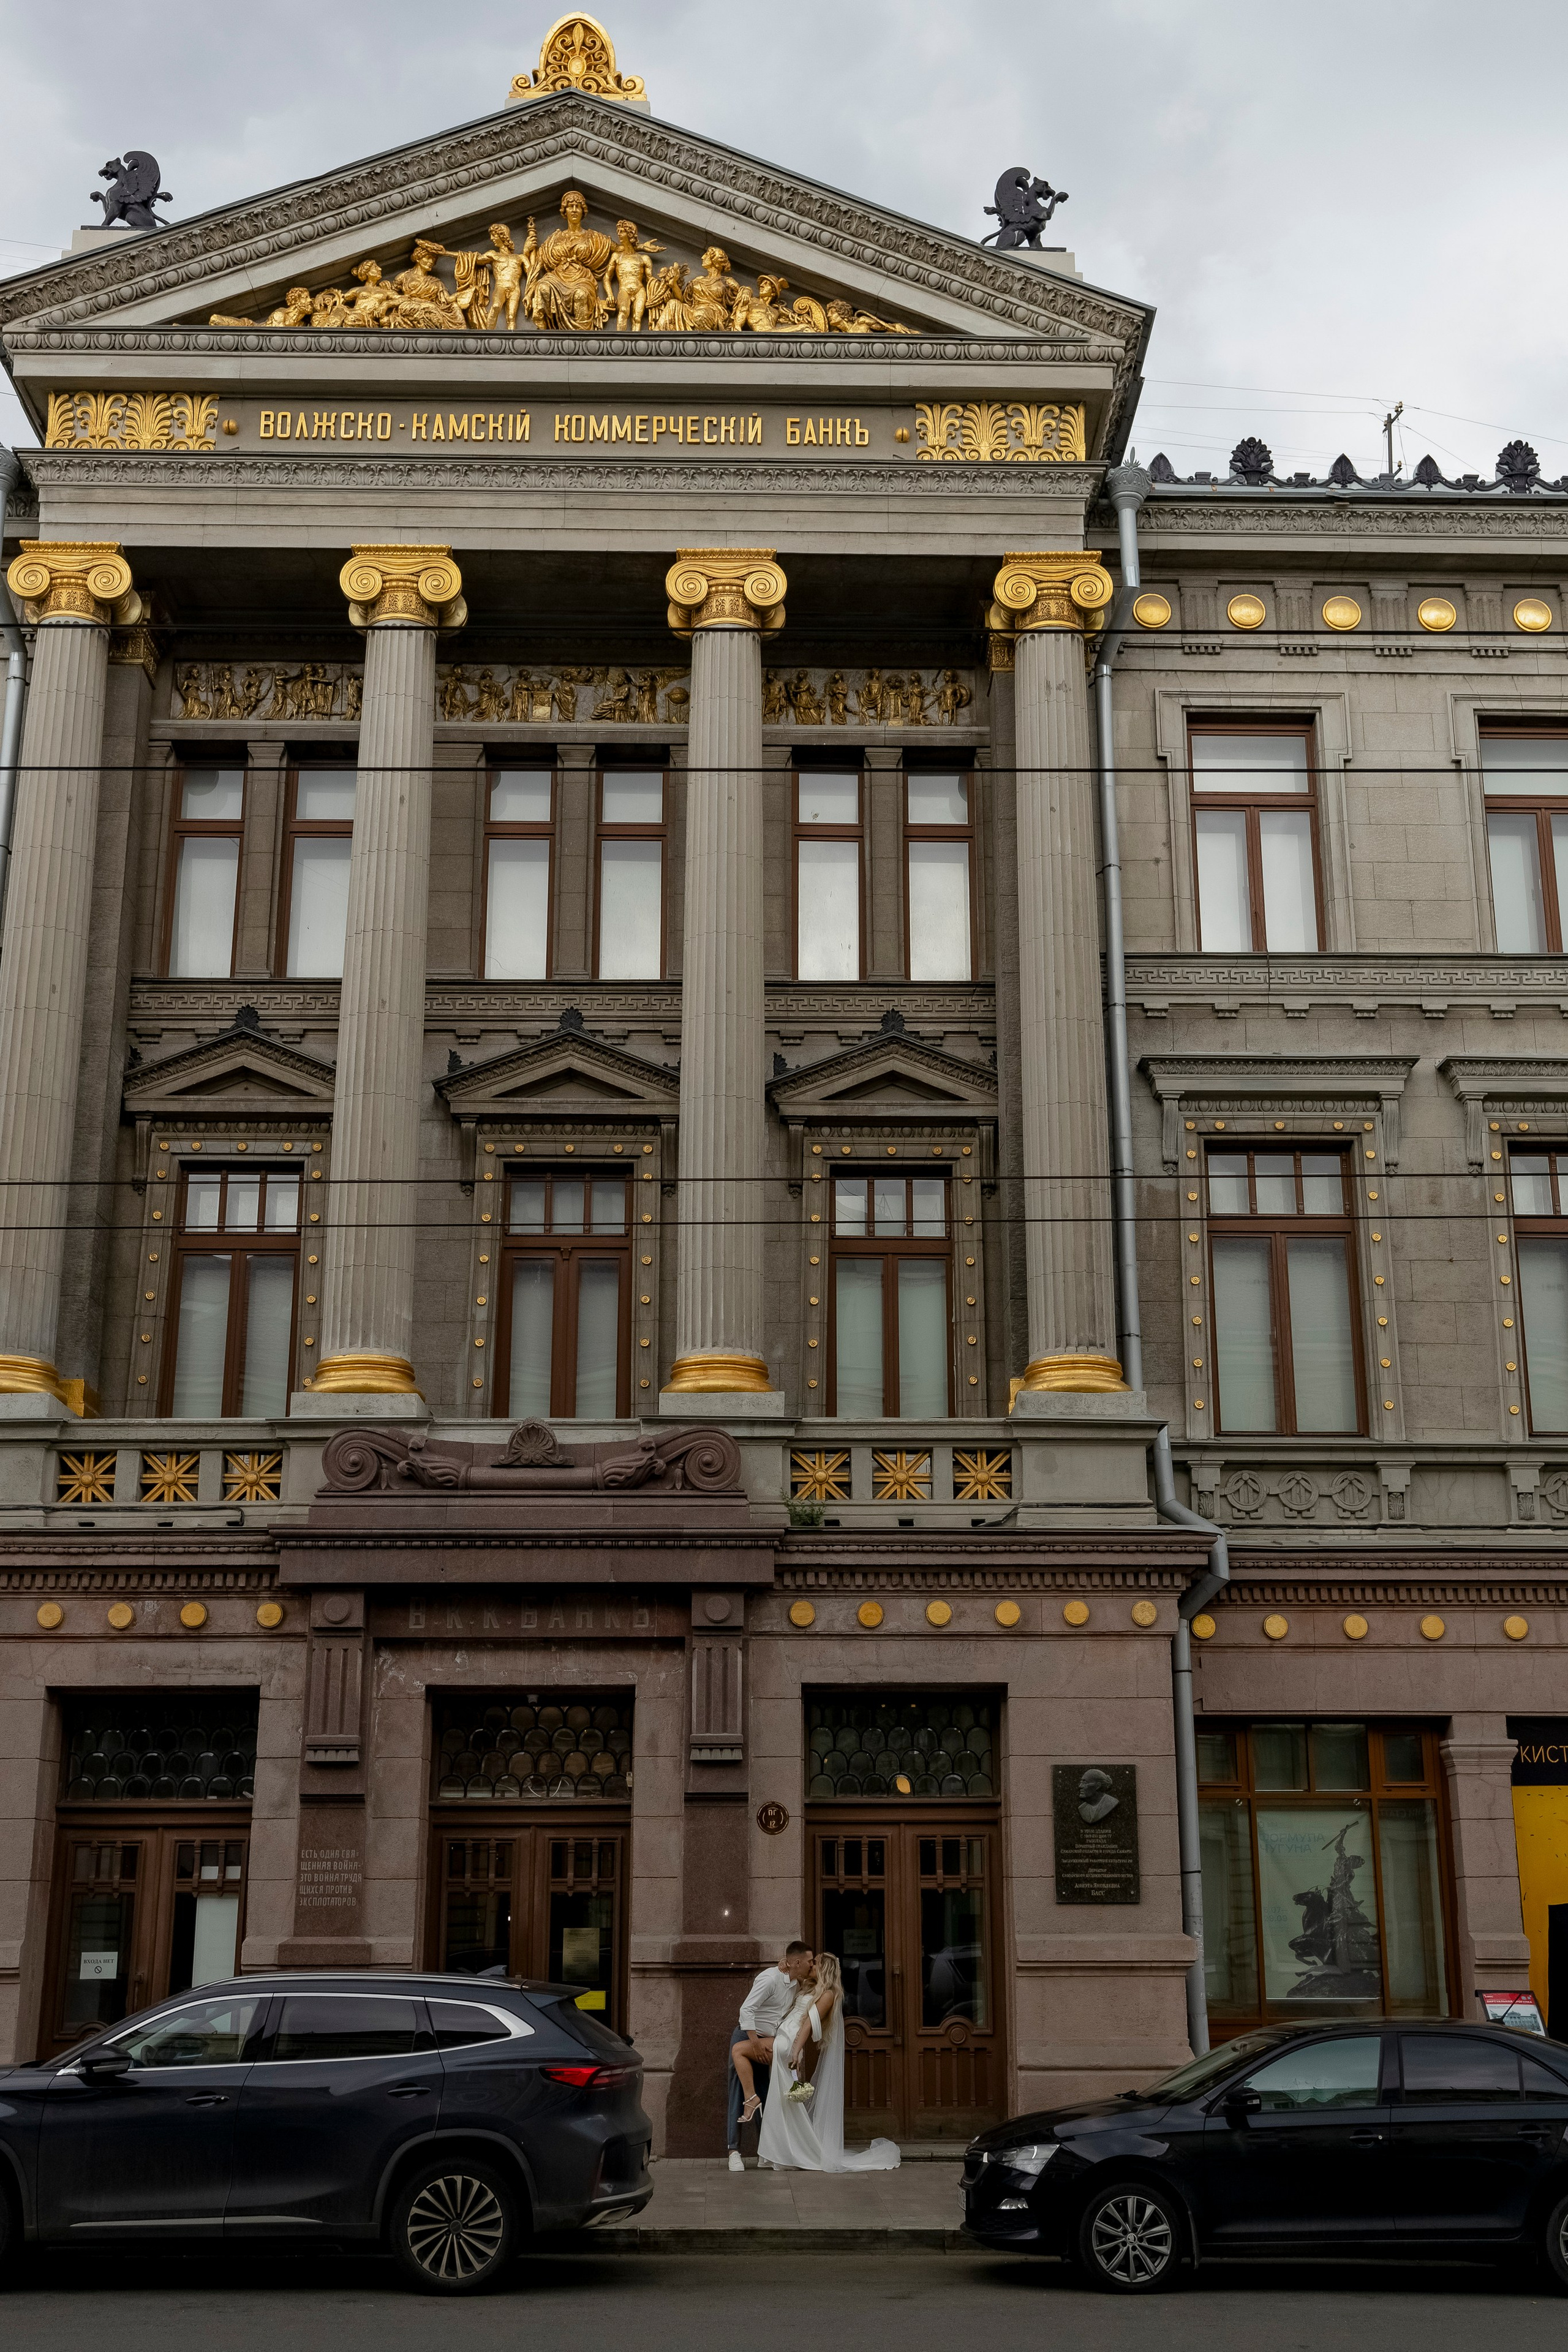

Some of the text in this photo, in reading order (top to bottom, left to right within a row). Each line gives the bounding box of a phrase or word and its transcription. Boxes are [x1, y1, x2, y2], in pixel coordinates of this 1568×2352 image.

[554, 413, 762, 446] КОММЕРЧЕСКІЙ
[786, 417, 869, 447] БАНКЪ
[1520, 1746, 1568, 1763] КИСТ
[301, 1850, 318, 1858] ЕСТЬ
[320, 1850, 339, 1859] ОДНА
[301, 1861, 331, 1871] ЩЕННАЯ
[300, 1872, 362, 1883] ЭТО ВОЙНА ТРУДЯ
[300, 1885, 353, 1895] ЩИХСЯ ПРОТИВ
